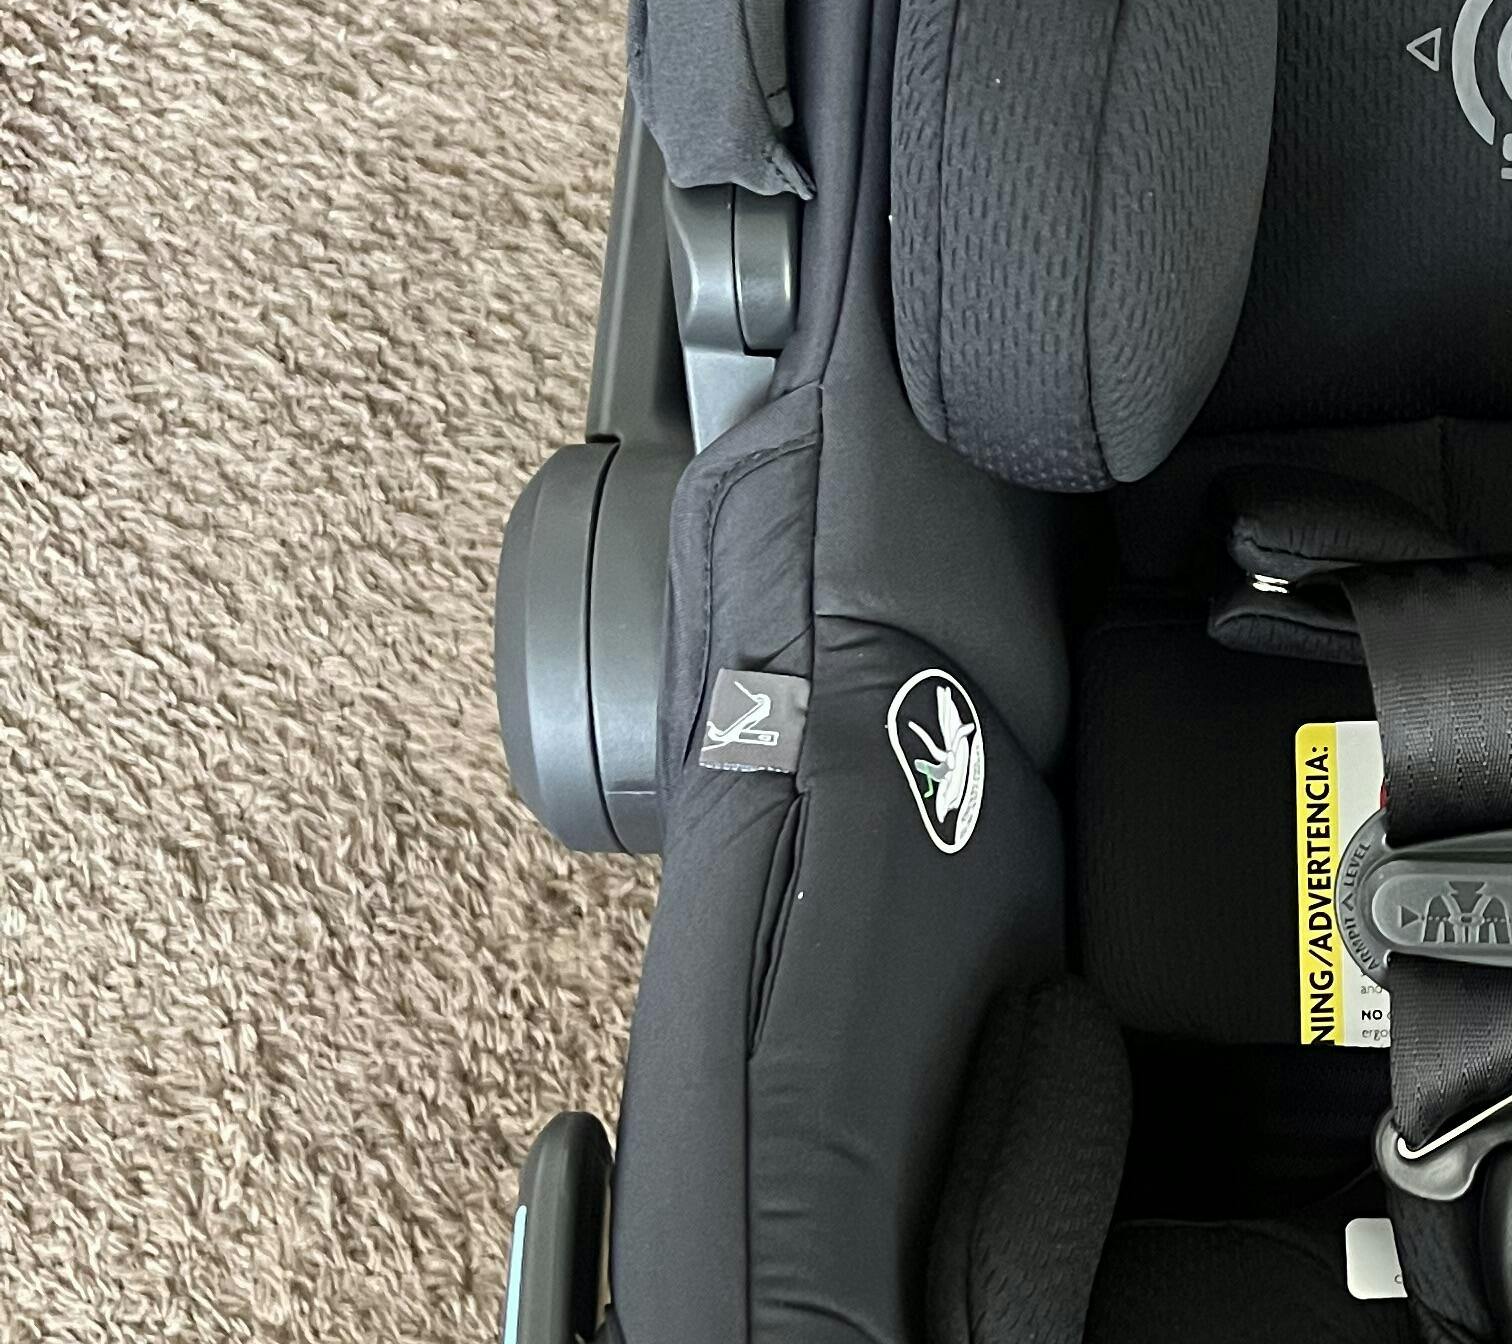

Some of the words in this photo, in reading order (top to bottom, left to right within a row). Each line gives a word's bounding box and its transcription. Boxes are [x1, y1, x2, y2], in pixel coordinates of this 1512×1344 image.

[1343, 842, 1372, 888] LEVEL
[1344, 917, 1382, 971] ARMPIT
[1361, 1009, 1383, 1021] NO
